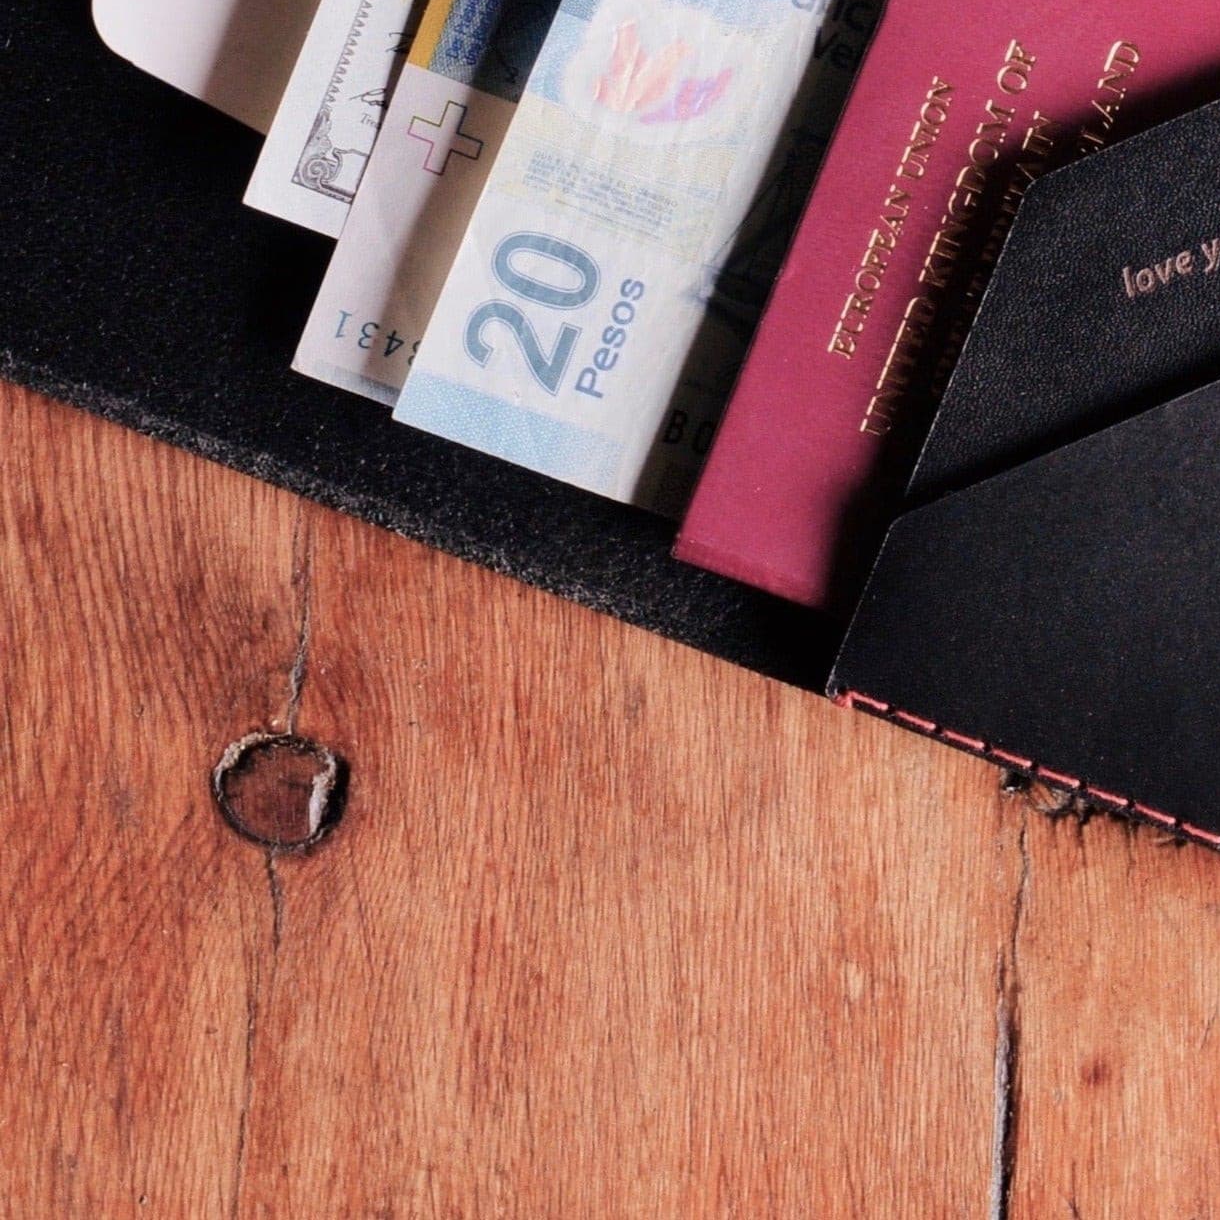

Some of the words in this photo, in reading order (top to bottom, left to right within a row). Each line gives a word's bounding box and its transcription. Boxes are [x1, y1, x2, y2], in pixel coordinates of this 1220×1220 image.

[827, 184, 911, 360] EUROPEAN
[896, 75, 953, 180] UNION
[860, 296, 935, 437] UNITED
[918, 99, 1016, 290] KINGDOM
[996, 38, 1037, 95] OF
[1122, 247, 1196, 298] love
[463, 230, 602, 397] 20
[573, 278, 645, 399] Pesos
